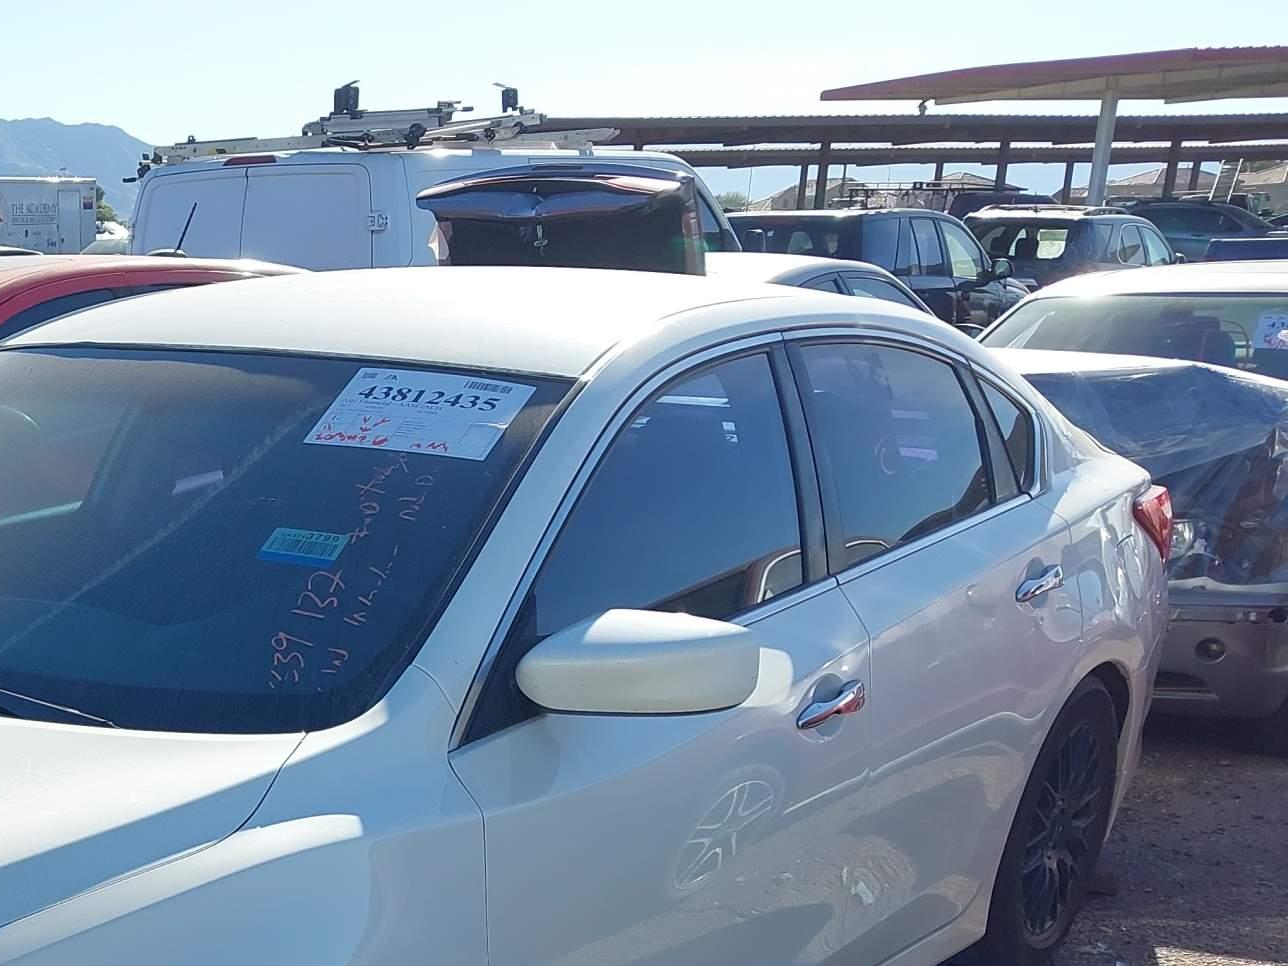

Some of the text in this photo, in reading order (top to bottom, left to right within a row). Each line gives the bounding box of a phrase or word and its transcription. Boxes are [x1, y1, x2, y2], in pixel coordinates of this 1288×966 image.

[11, 203, 58, 214] THE ACADEMY
[357, 384, 502, 412] 43812435
